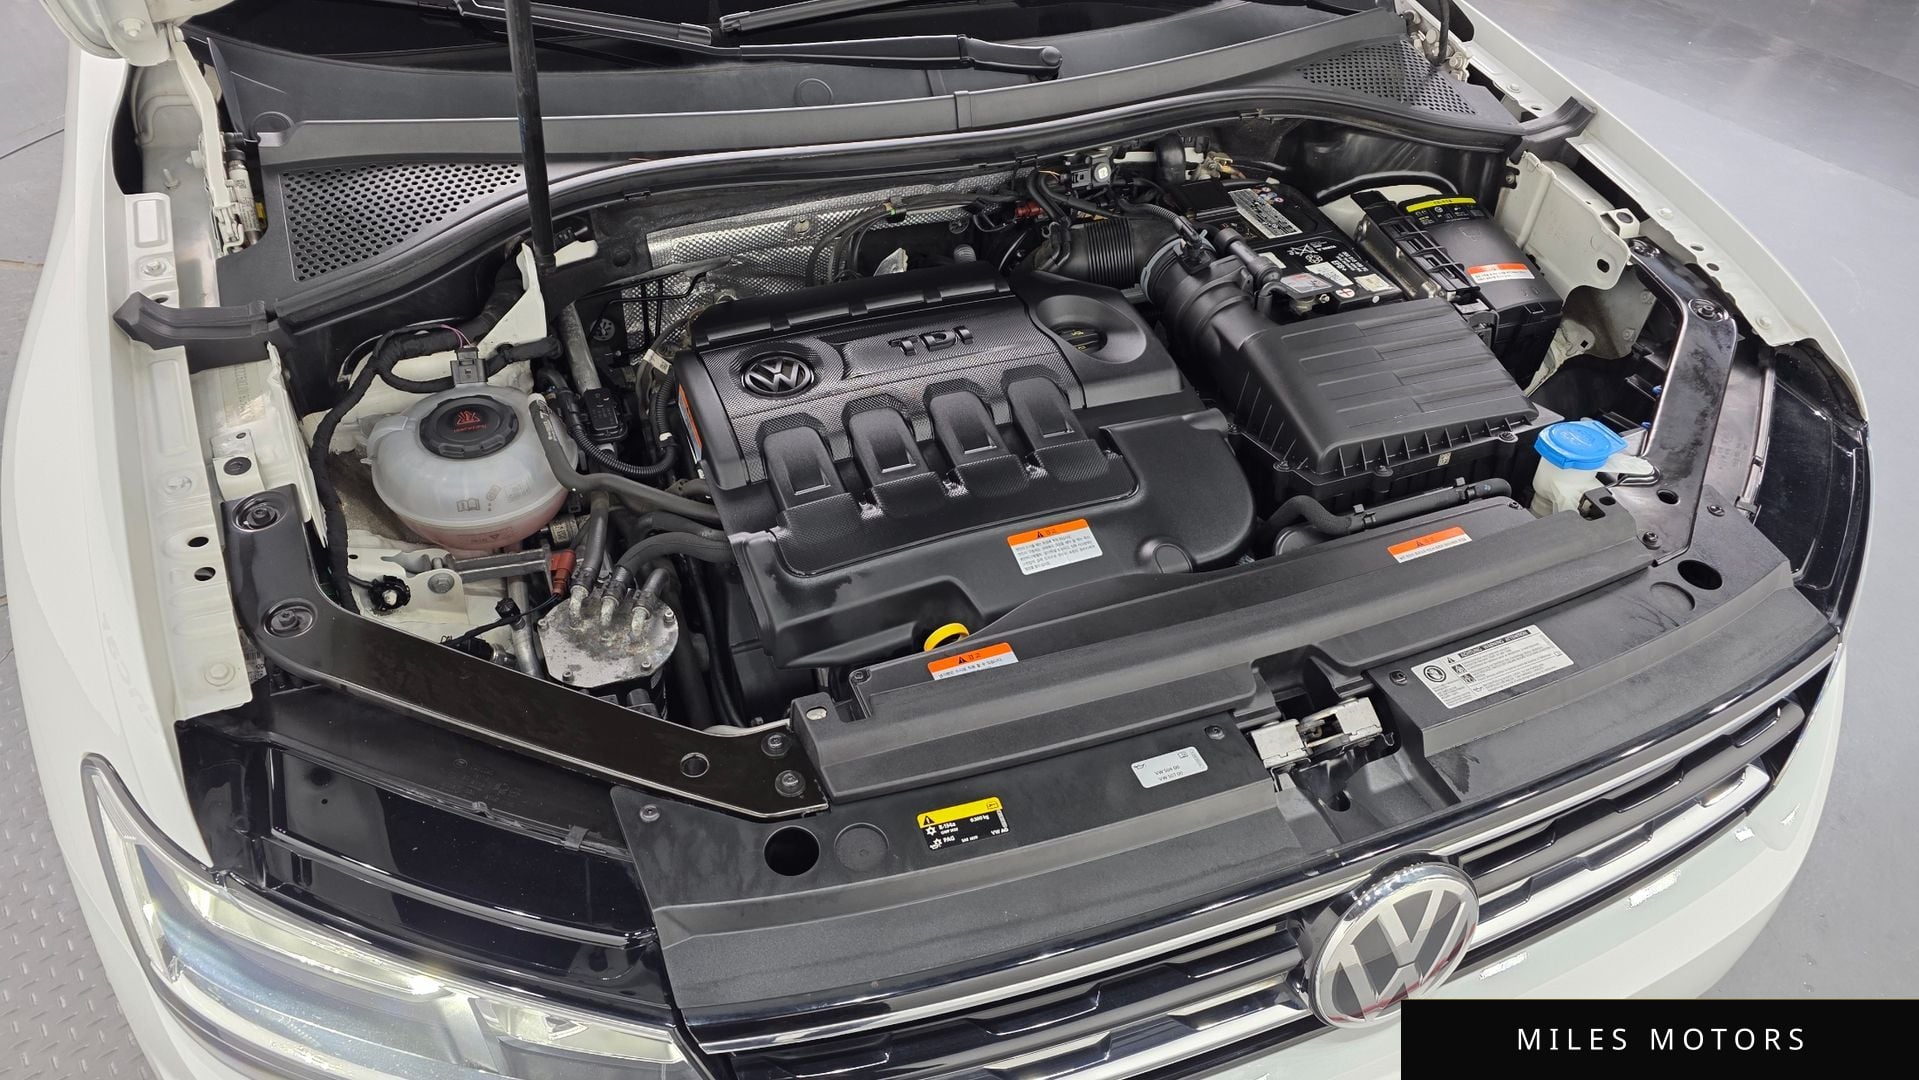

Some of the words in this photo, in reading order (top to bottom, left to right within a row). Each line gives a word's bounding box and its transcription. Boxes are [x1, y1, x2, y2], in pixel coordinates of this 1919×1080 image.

[888, 326, 973, 356] TDI
[745, 356, 811, 394] VW
[1315, 870, 1478, 1024] VW
